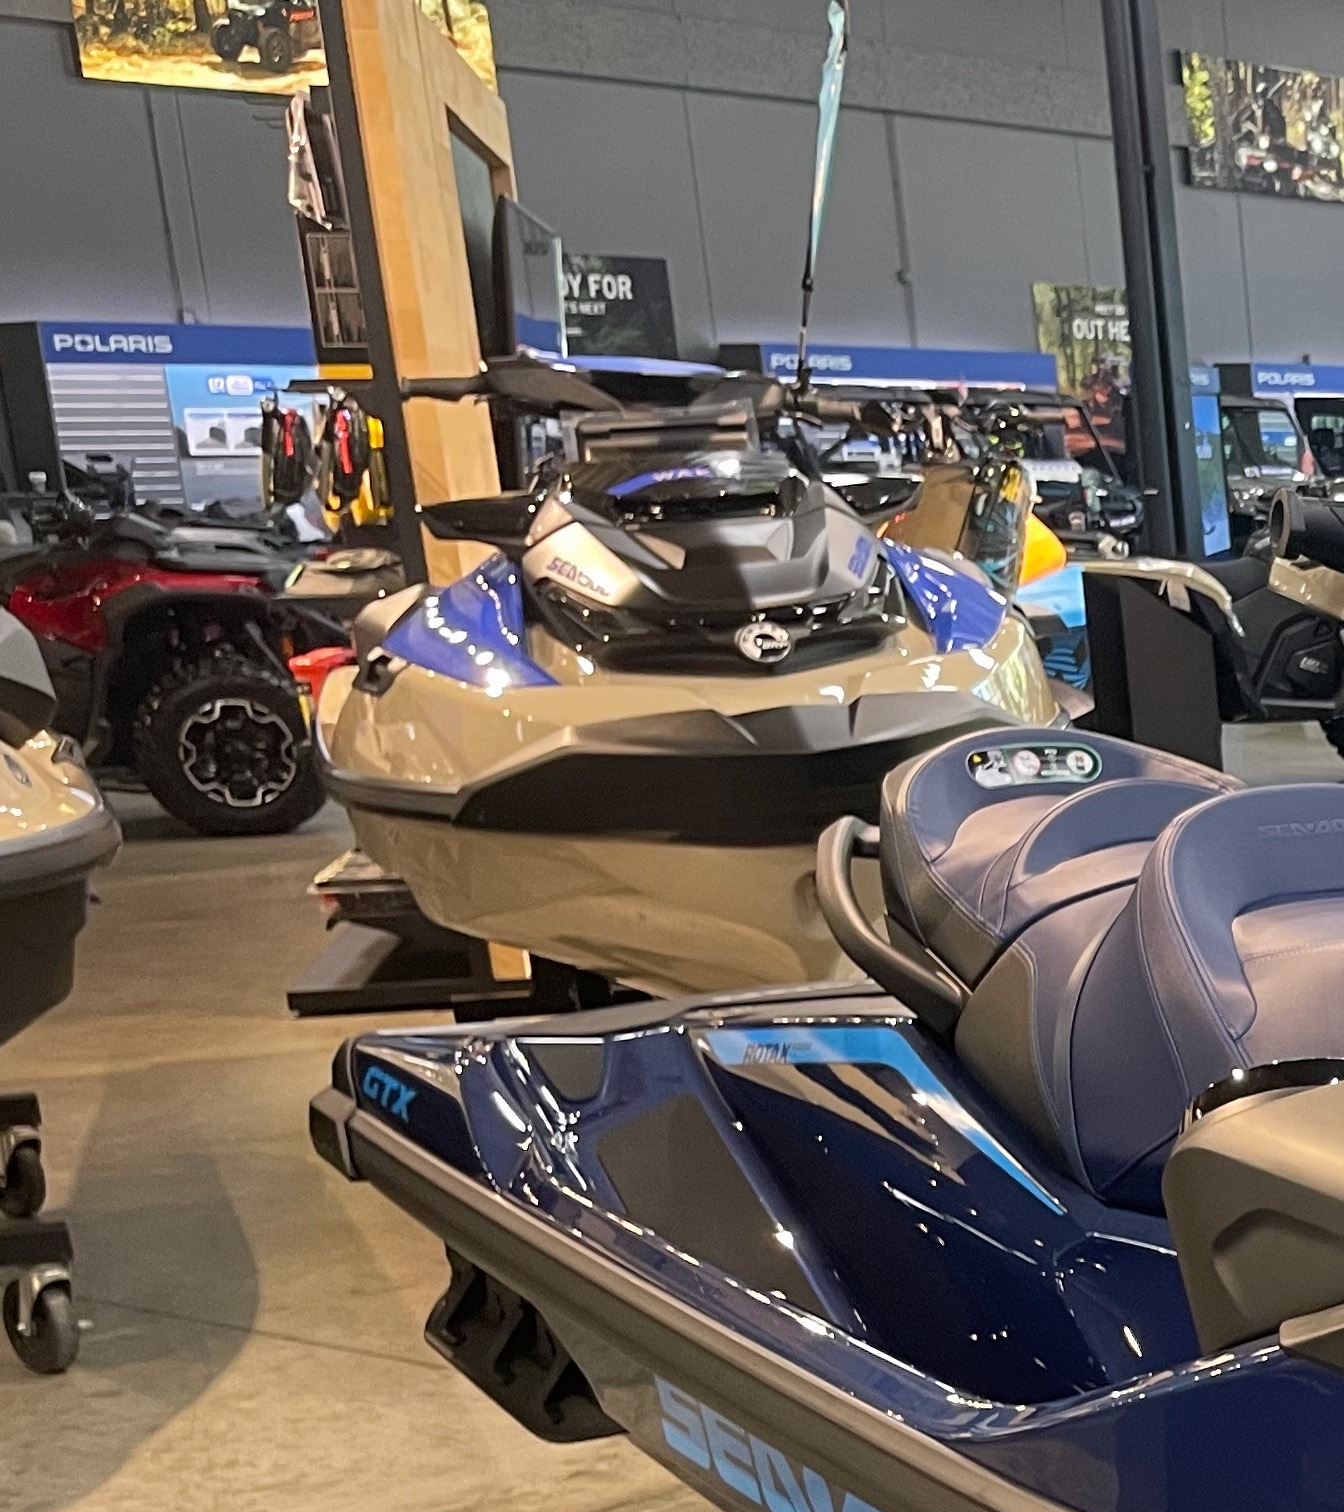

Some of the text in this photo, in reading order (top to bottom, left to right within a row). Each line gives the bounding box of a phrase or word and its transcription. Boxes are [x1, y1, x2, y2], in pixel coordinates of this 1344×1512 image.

[587, 273, 632, 299] FOR
[1072, 318, 1131, 341] OUT HE
[53, 334, 172, 354] POLARIS
[770, 352, 852, 371] POARIS
[742, 1042, 791, 1065] ROTAX
[363, 1065, 417, 1125] GTX
